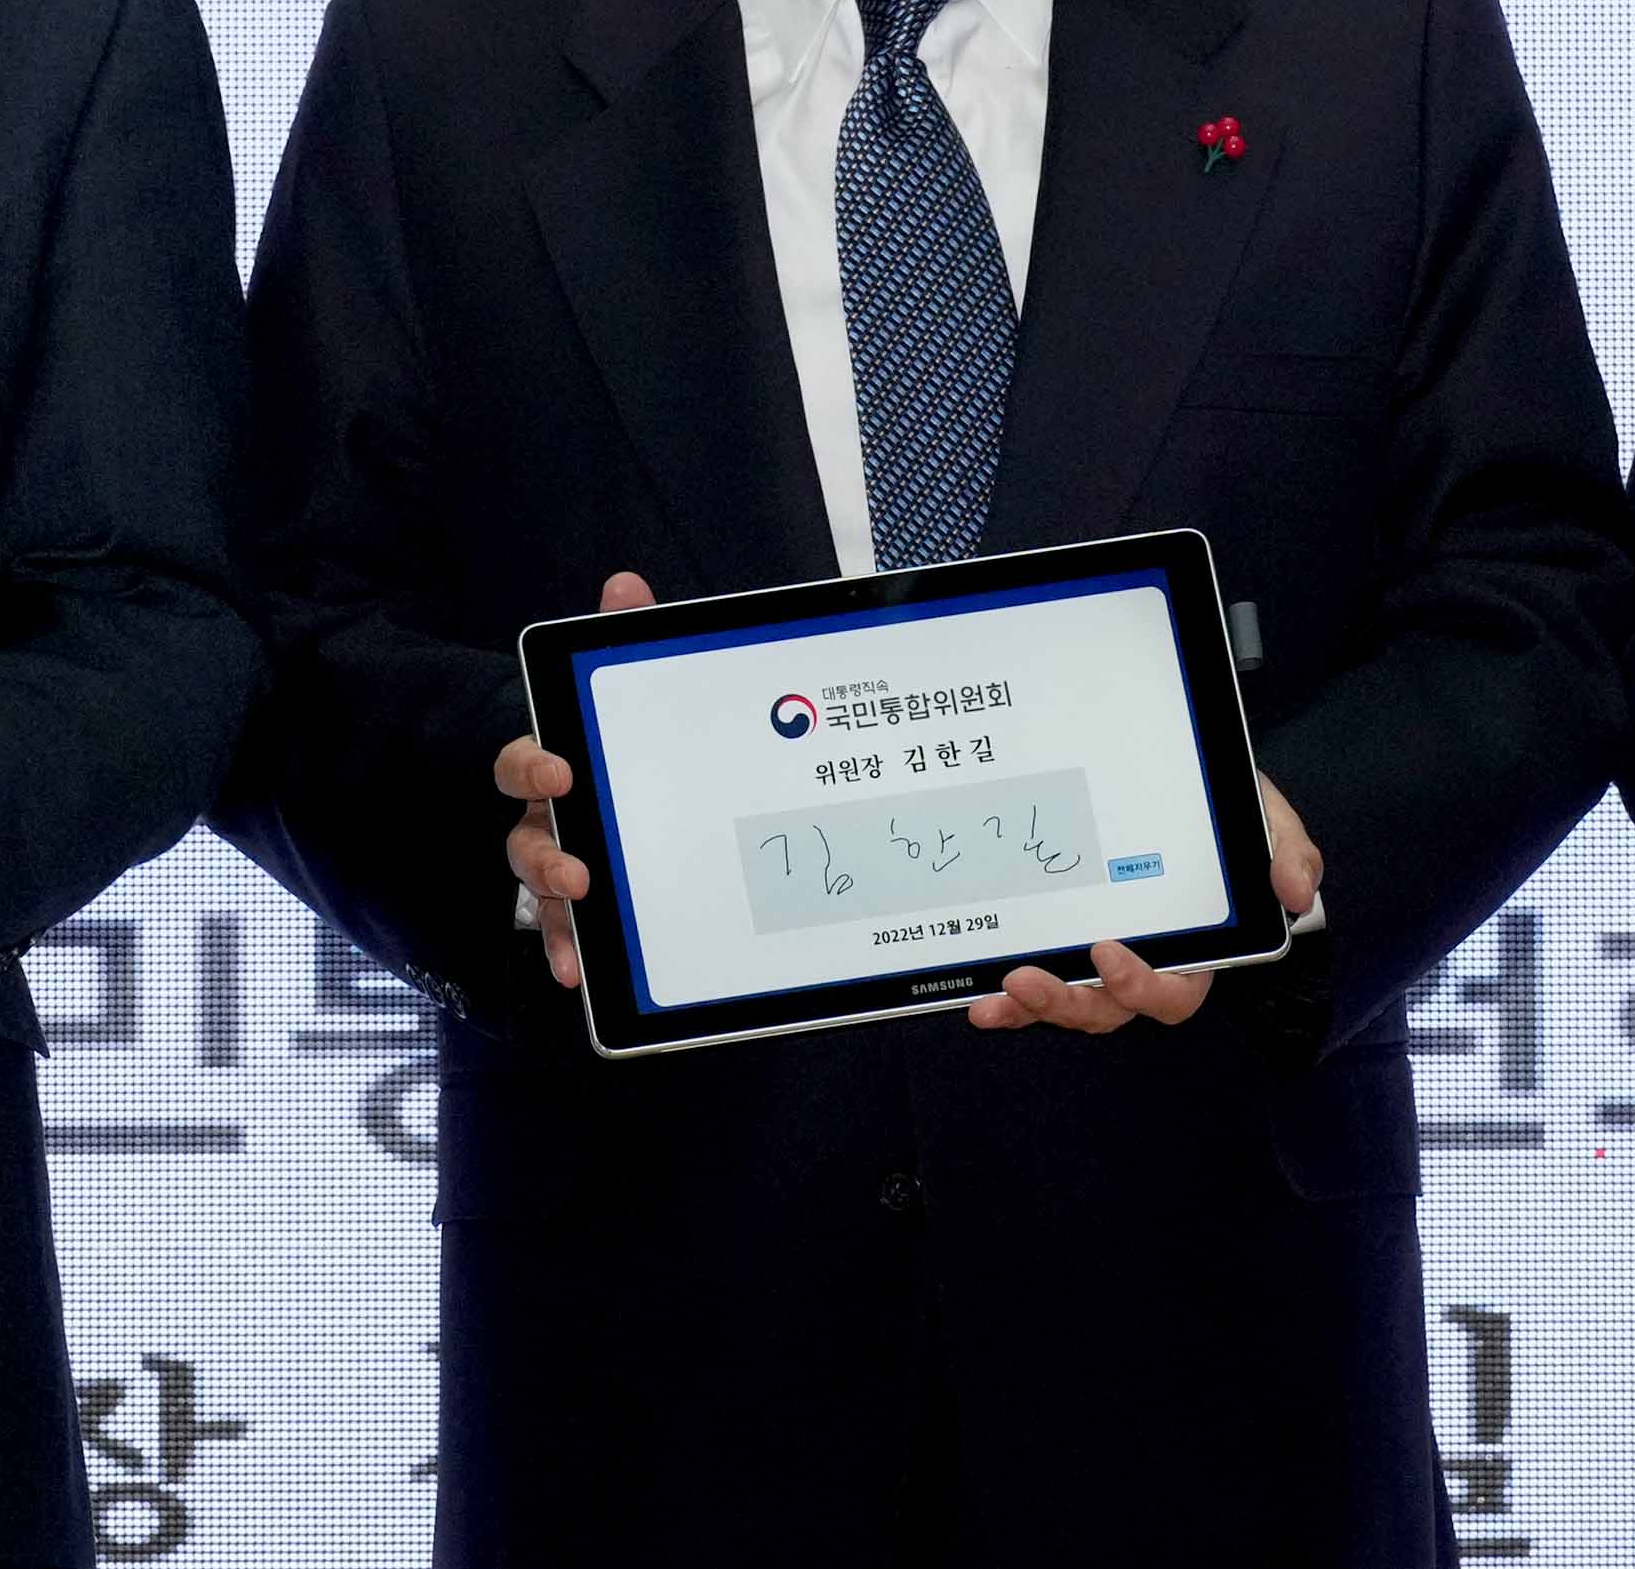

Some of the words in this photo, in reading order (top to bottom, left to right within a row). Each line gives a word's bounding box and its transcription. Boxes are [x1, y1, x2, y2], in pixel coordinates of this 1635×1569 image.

[822, 679, 889, 701] 대통령직속
[826, 681, 1013, 731] 국민통합위원회
[815, 754, 884, 786] 위원장
[872, 924, 924, 946] 2022년
[929, 918, 961, 937] 12월
[966, 914, 999, 932] 29일
[911, 976, 974, 996] SAMSUNG
